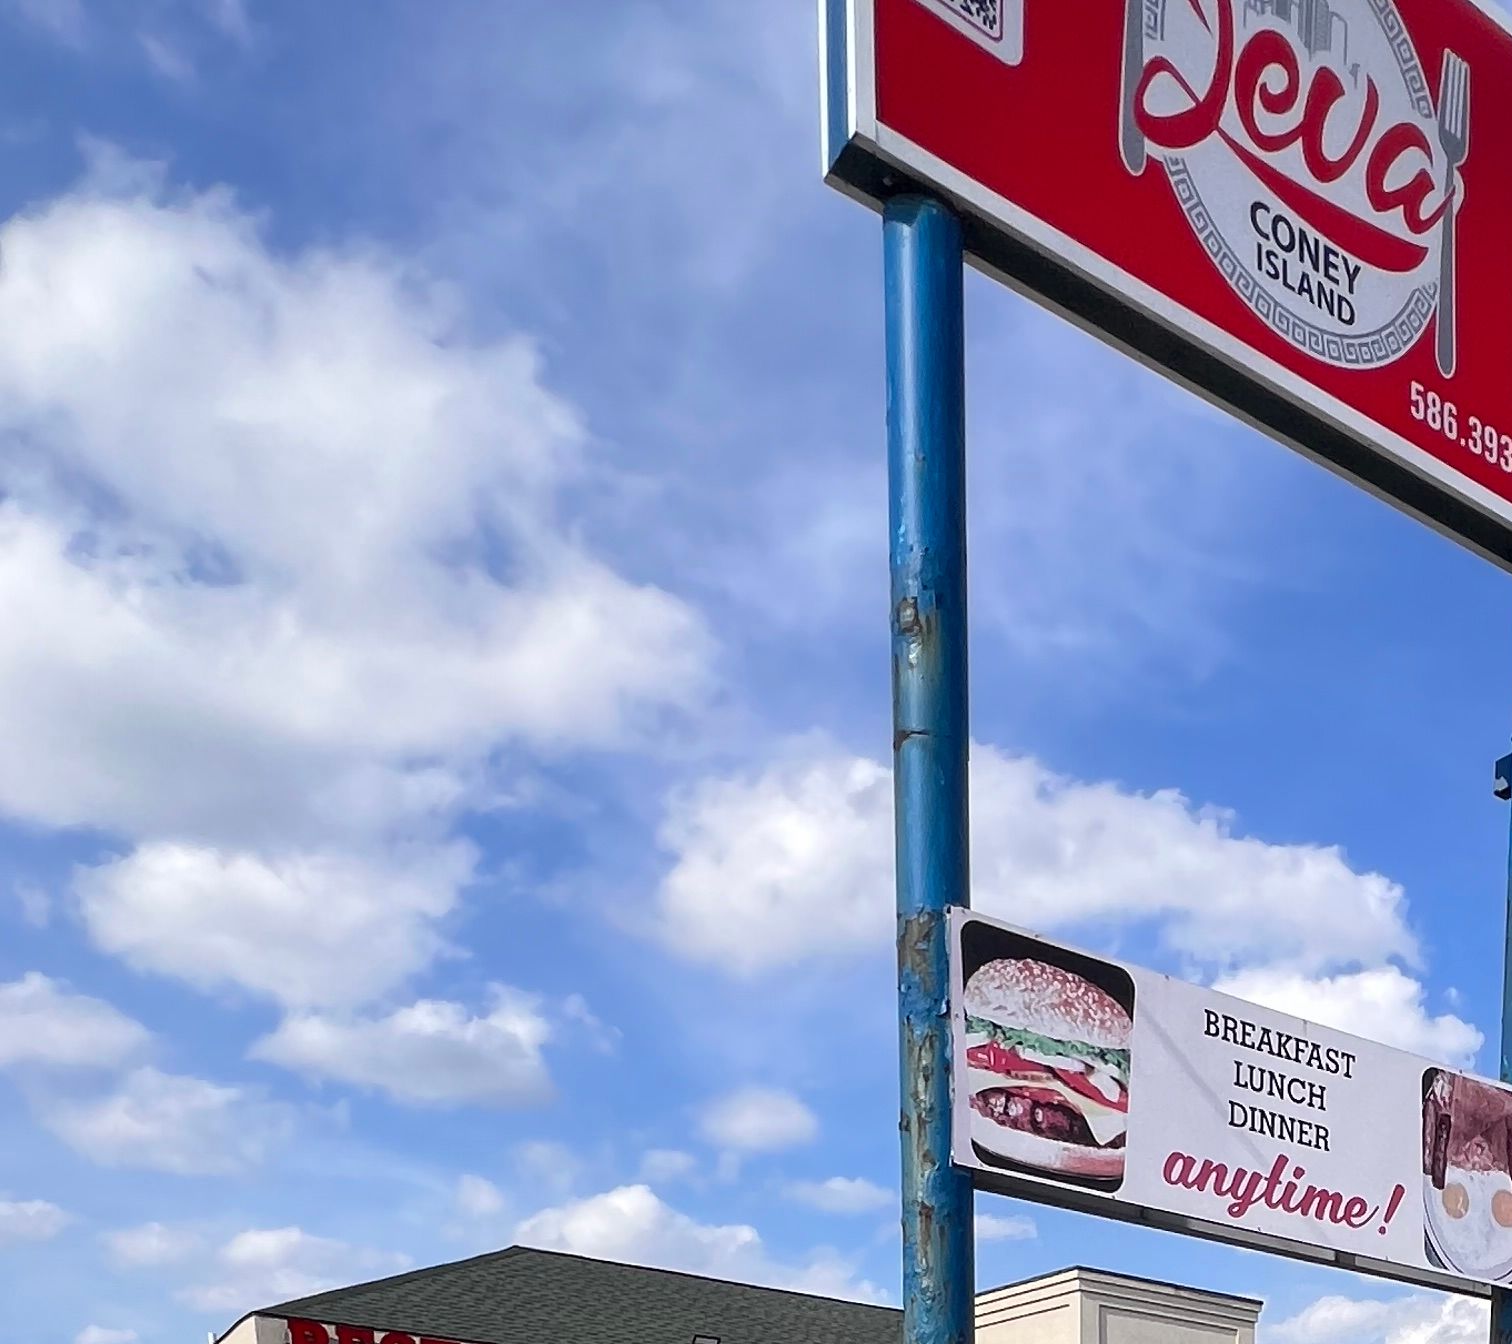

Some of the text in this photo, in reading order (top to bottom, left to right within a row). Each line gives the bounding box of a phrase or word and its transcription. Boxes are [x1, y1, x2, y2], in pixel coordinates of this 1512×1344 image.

[1249, 200, 1362, 295] CONEY
[1256, 240, 1356, 327] ISLAND
[1204, 1008, 1356, 1079] BREAKFAST
[1233, 1060, 1326, 1111] LUNCH
[1228, 1100, 1330, 1151] DINNER
[1163, 1151, 1406, 1235] anytime!
